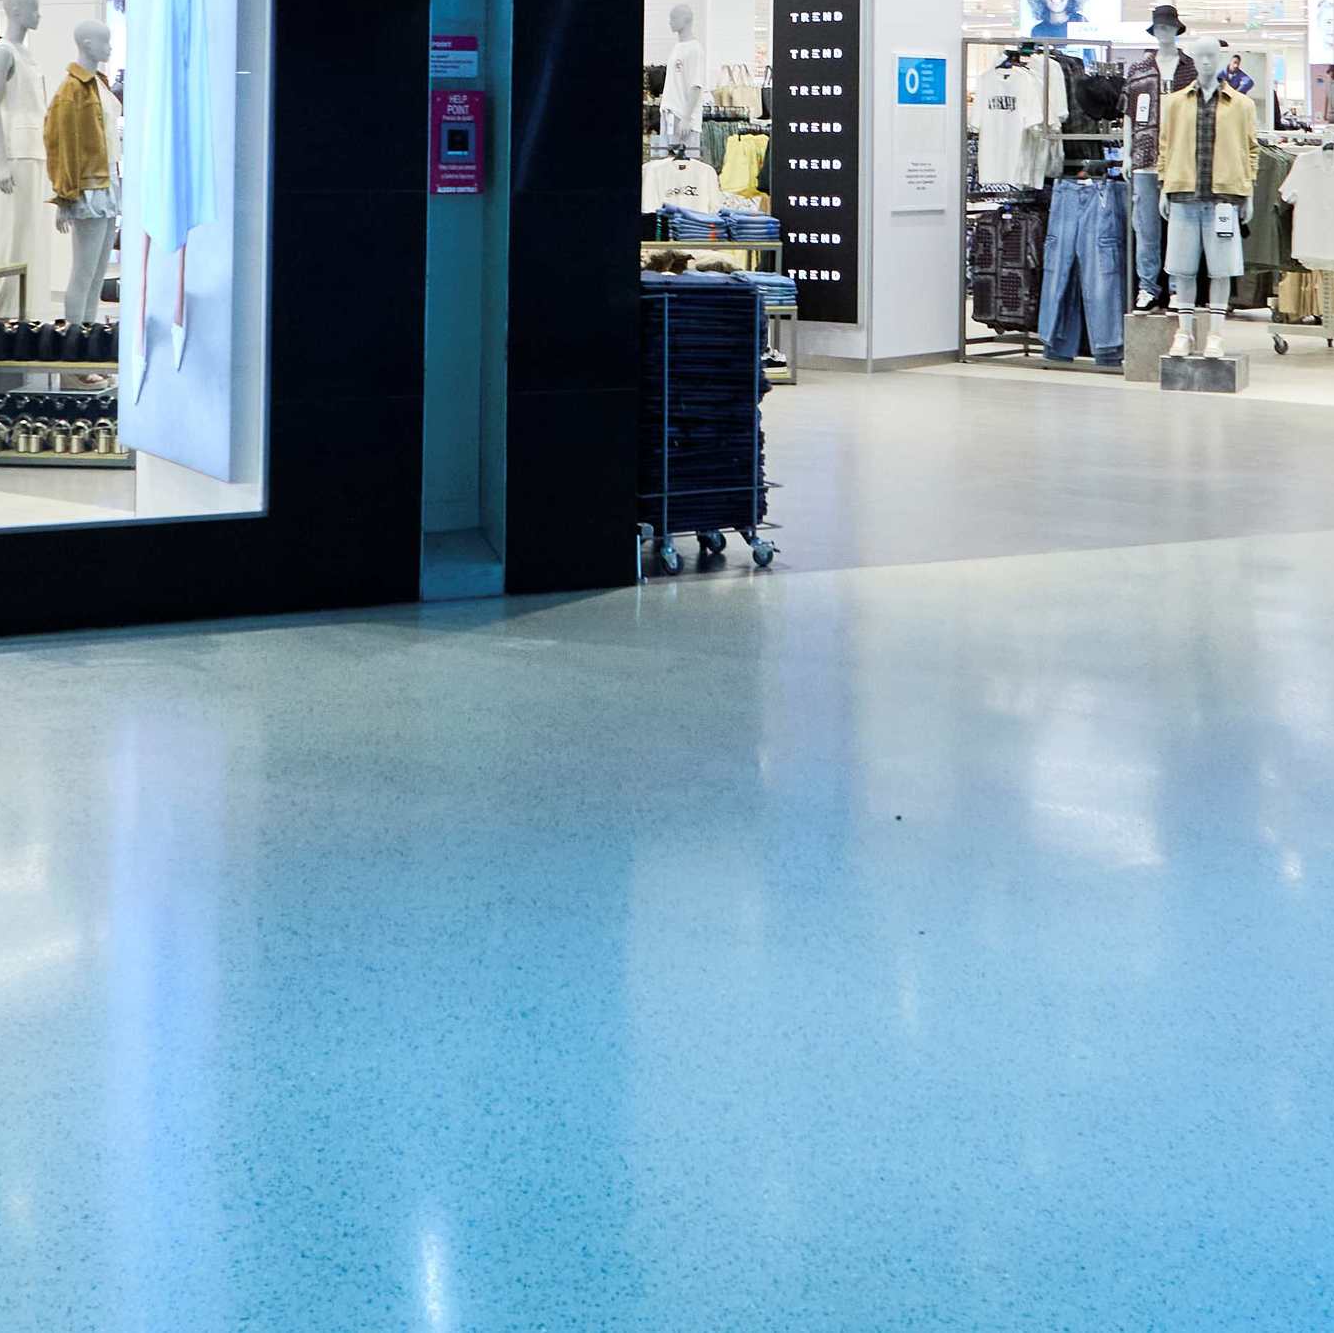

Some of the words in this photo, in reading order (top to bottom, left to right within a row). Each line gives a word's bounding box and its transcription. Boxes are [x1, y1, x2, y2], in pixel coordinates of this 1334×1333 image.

[790, 11, 843, 22] TREND
[790, 48, 842, 60] TREND
[789, 85, 842, 96] TREND
[447, 104, 470, 116] POINT
[789, 122, 842, 133] TREND
[788, 159, 841, 169] TREND
[788, 195, 841, 207] TREND
[788, 233, 841, 244] TREND
[788, 269, 841, 281] TREND
